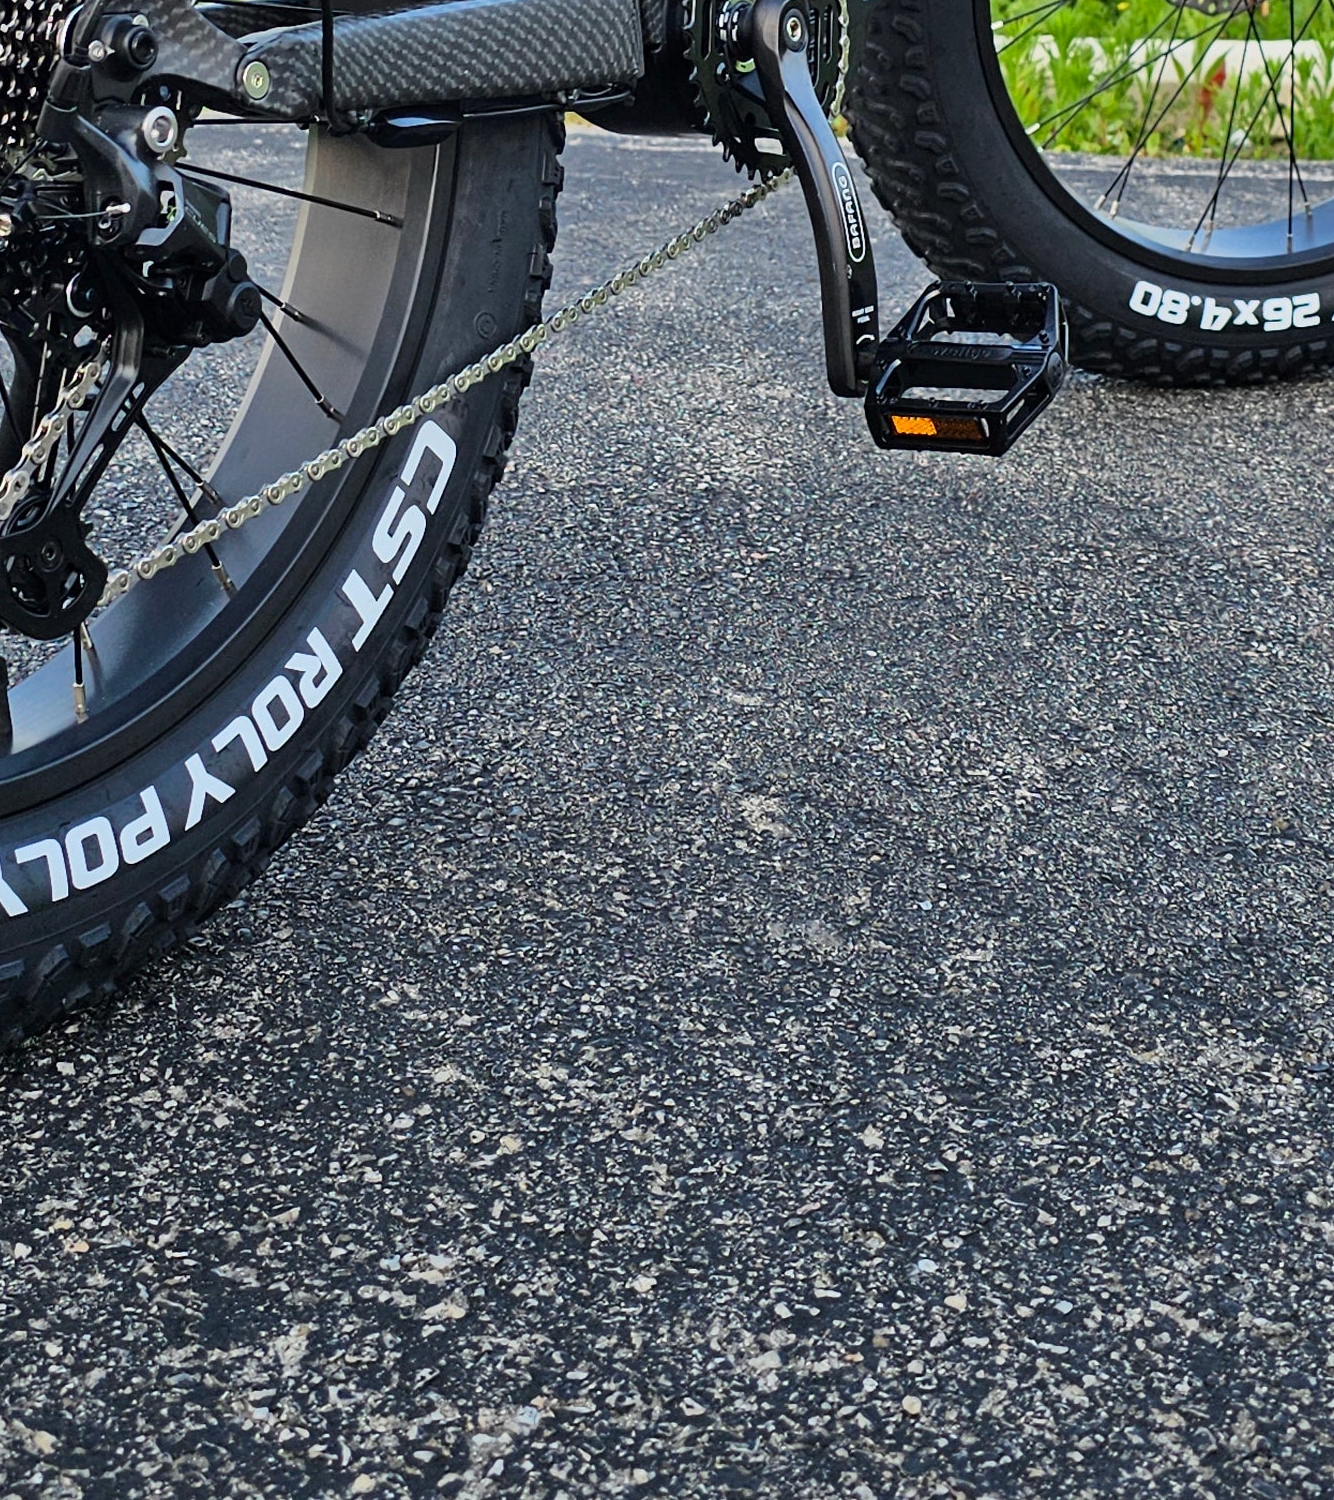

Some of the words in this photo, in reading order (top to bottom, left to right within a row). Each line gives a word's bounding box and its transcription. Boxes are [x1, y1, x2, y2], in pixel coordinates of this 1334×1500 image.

[838, 175, 862, 250] BAFANG
[1128, 278, 1322, 333] 26x4.80
[340, 419, 458, 653] CST
[182, 624, 344, 833] ROLY
